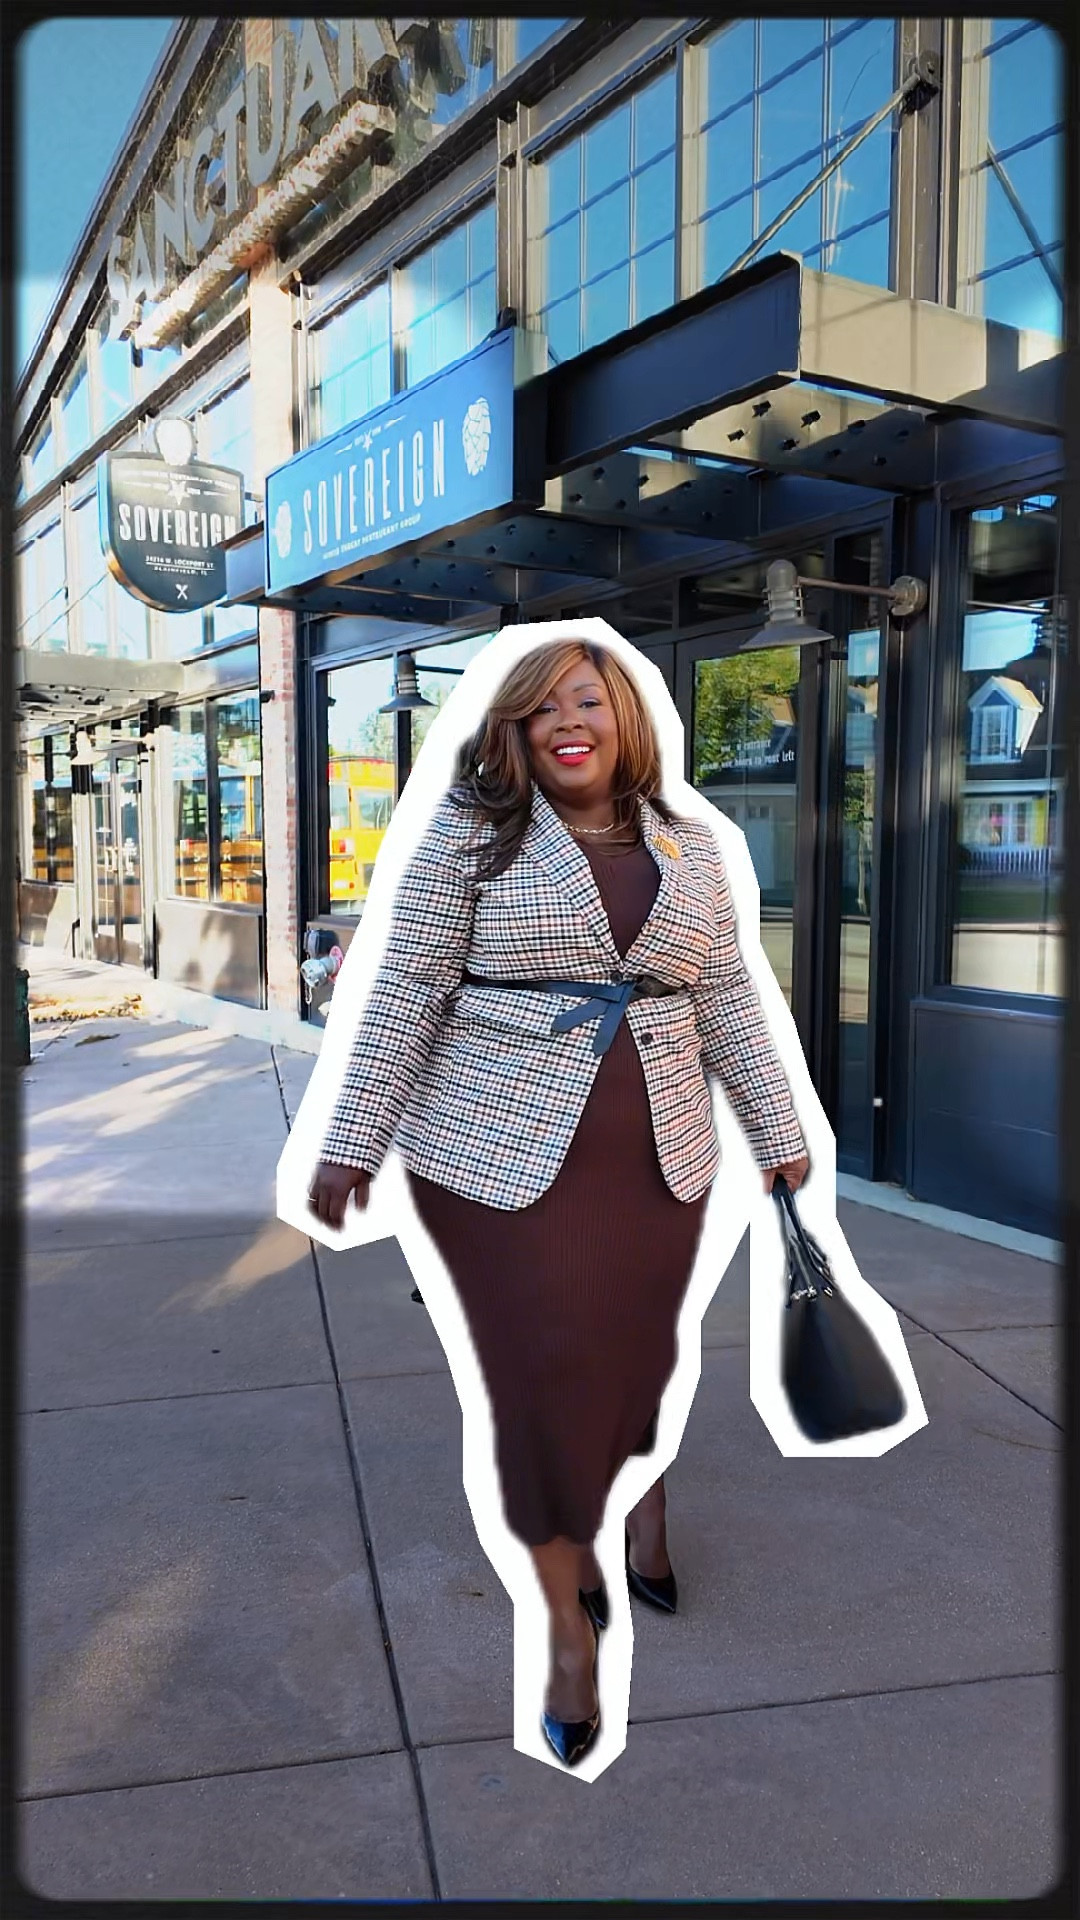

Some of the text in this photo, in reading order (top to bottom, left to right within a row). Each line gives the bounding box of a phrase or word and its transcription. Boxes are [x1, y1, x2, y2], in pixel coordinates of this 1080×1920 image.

[303, 419, 445, 555] SOVEREIGN
[118, 503, 236, 548] SOVEREIGN
[174, 558, 205, 568] LOCKPORT
[782, 749, 795, 762] left
